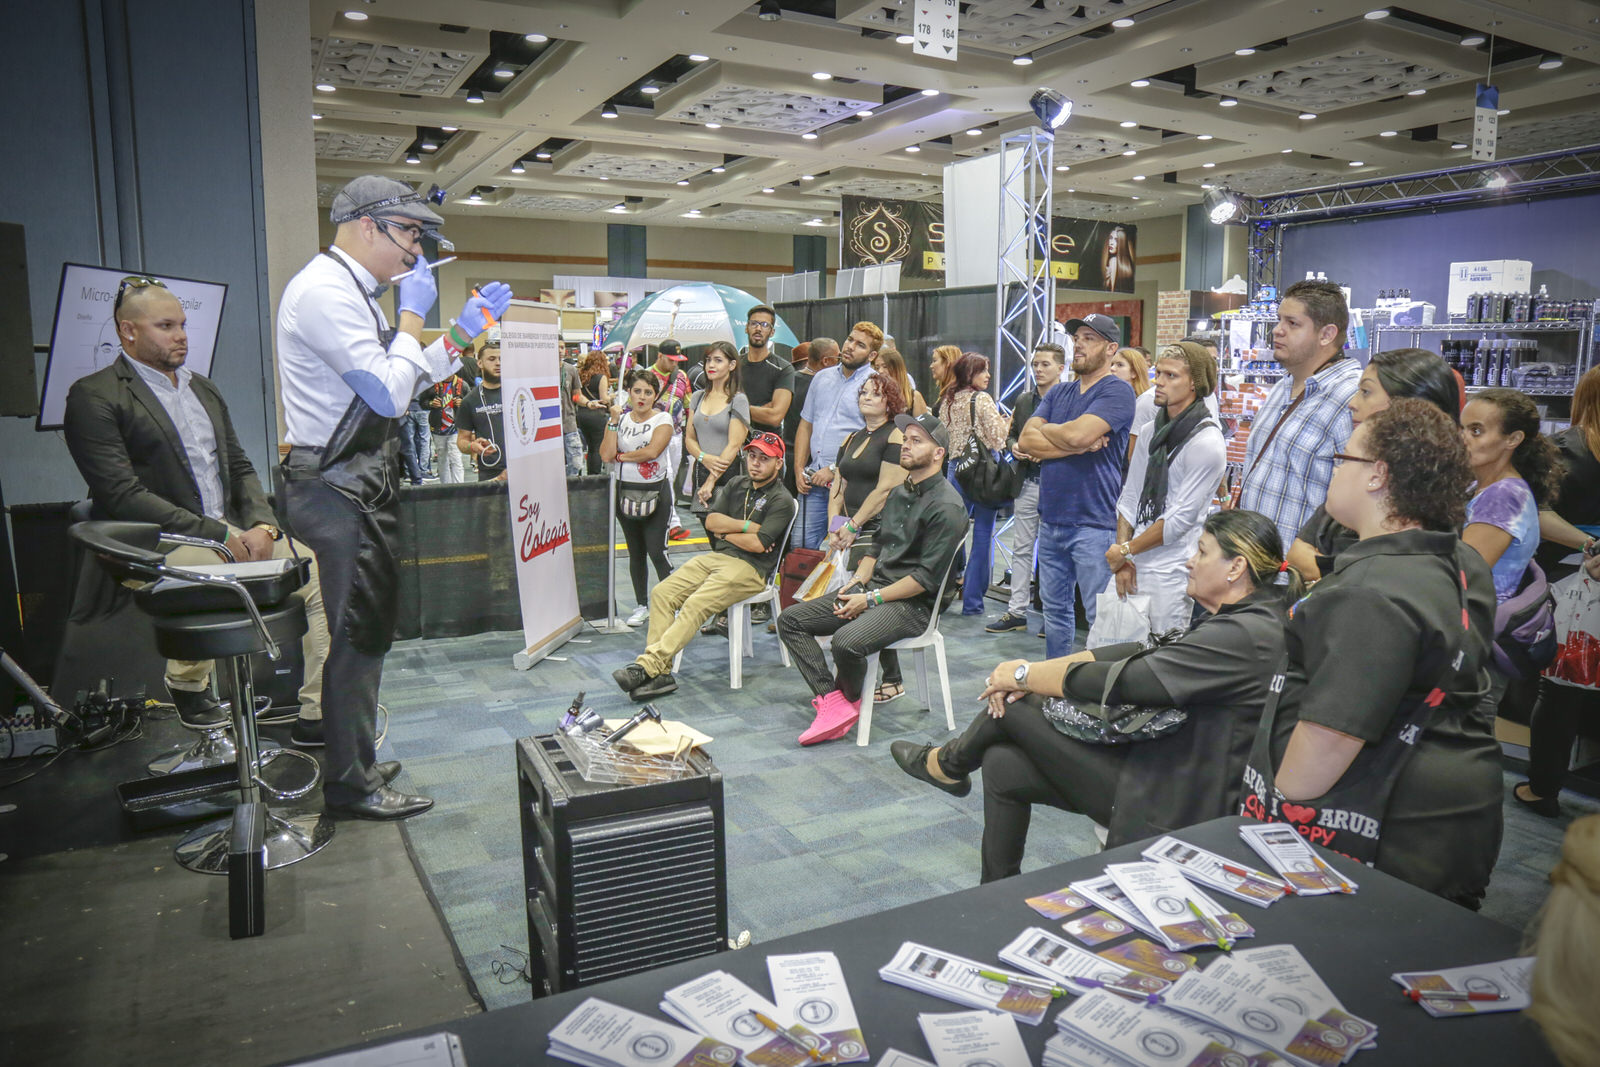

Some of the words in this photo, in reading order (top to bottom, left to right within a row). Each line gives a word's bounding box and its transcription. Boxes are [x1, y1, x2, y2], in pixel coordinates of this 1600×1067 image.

[918, 23, 931, 35] 178
[942, 28, 955, 39] 164
[517, 494, 541, 523] Soy
[1317, 808, 1380, 841] ARUB
